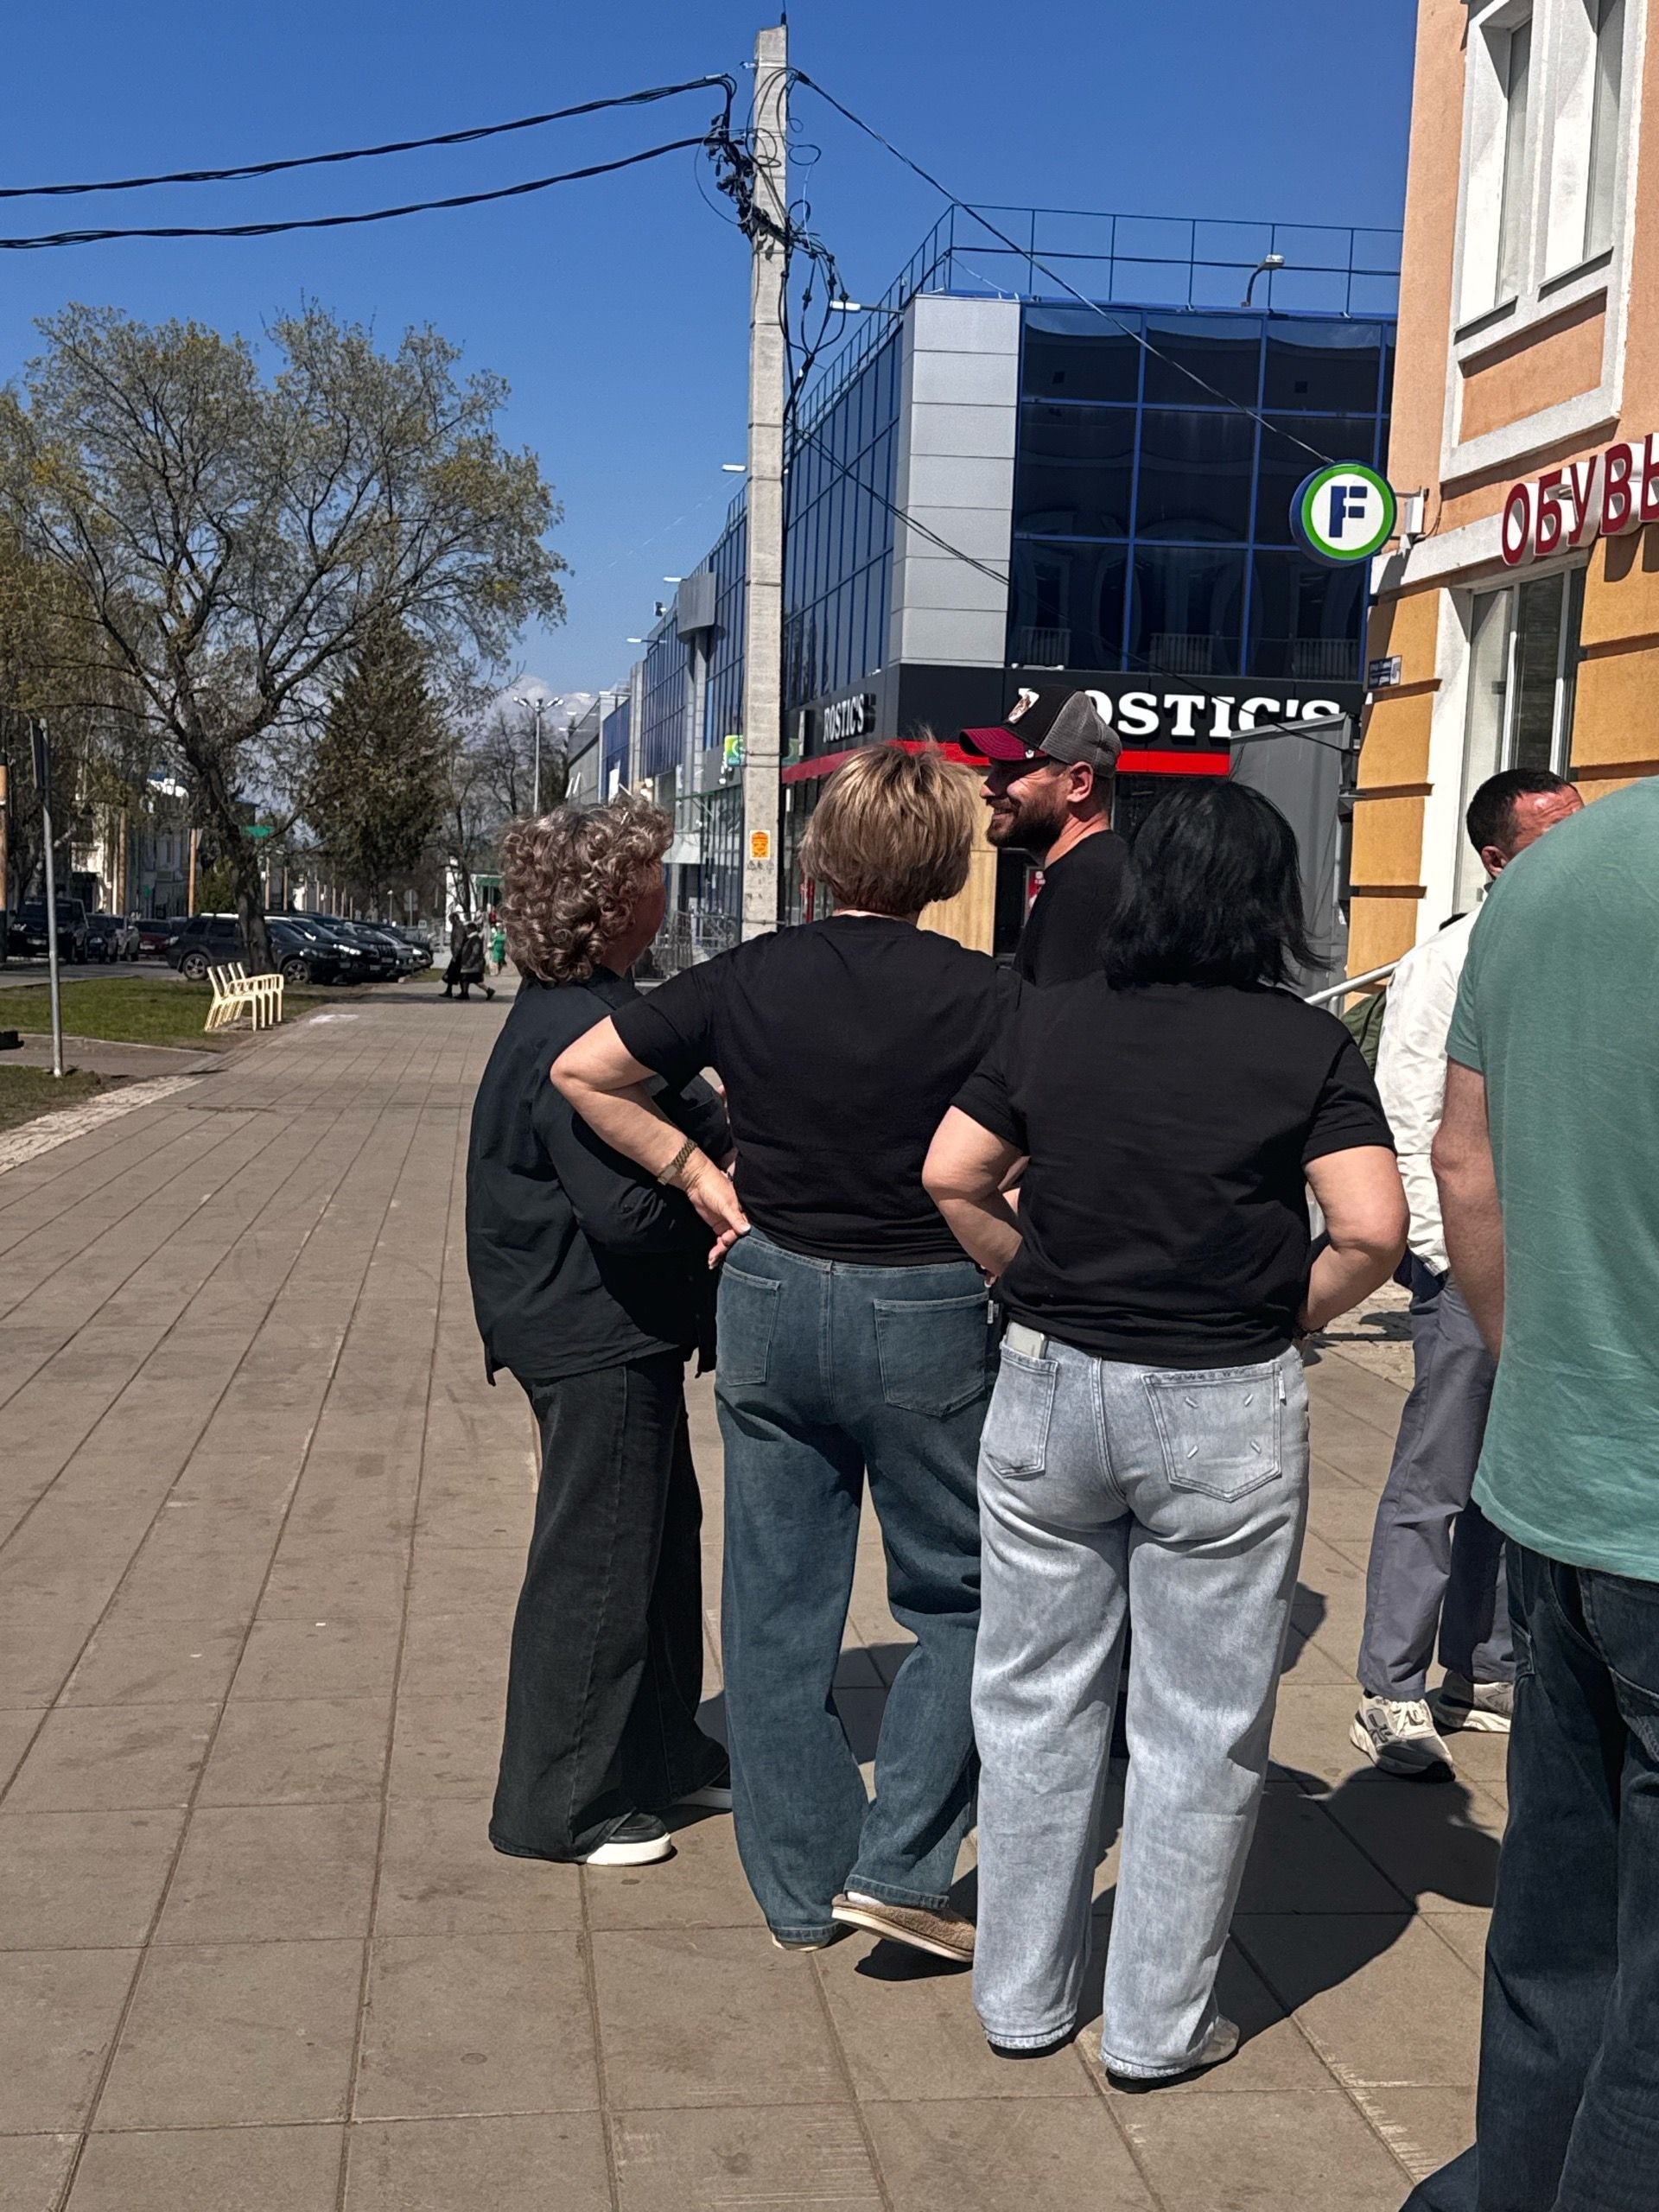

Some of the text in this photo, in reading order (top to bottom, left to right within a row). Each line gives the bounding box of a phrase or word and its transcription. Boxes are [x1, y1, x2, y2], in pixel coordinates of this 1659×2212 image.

[1329, 486, 1368, 538] F
[823, 693, 864, 743] ROSTIC'S
[1019, 688, 1339, 738] STIC'
